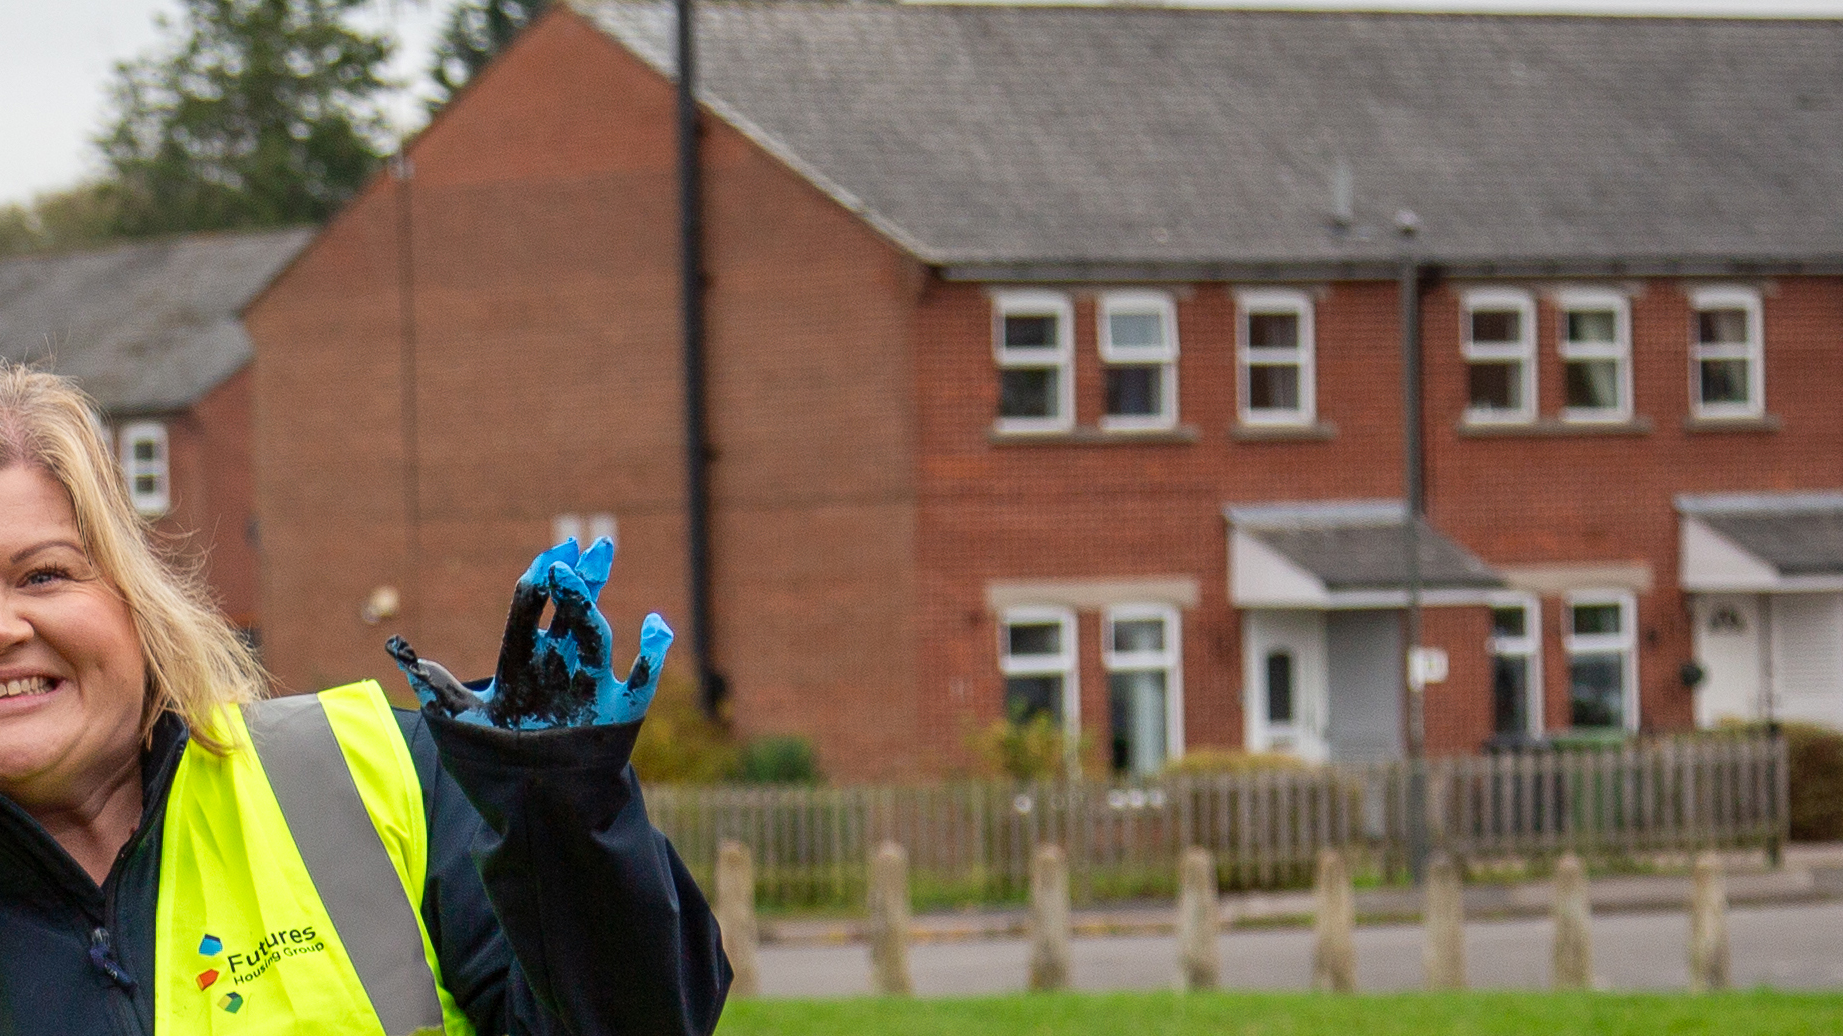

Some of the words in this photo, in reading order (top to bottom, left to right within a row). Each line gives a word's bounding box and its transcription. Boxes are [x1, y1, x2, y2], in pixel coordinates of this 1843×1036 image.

[227, 926, 317, 973] Futures
[233, 951, 281, 986] Housing
[283, 941, 325, 957] Group
